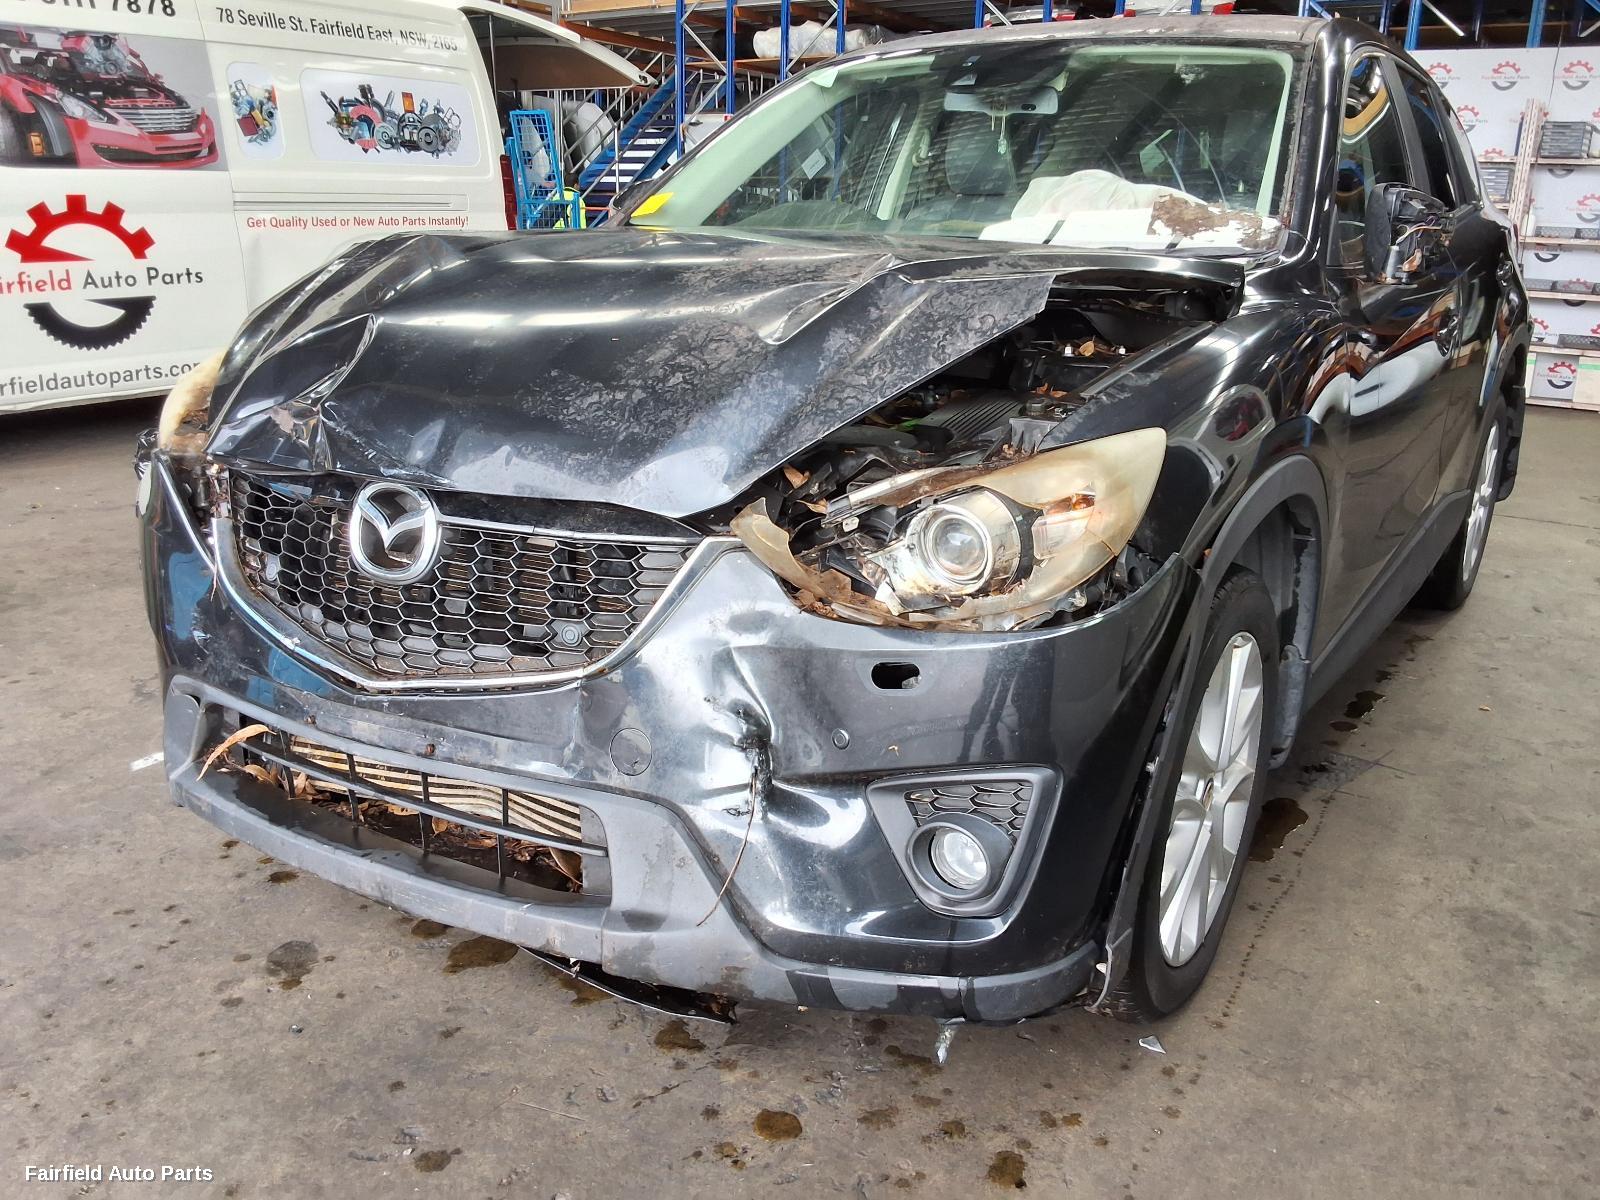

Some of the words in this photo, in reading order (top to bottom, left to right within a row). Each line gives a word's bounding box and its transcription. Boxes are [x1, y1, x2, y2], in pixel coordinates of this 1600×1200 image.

[215, 7, 234, 24] 78
[238, 9, 286, 29] Seville
[289, 16, 308, 32] St.
[311, 18, 364, 39] Fairfield
[367, 25, 398, 46] East,
[246, 216, 266, 228] Get
[270, 216, 308, 229] Quality
[311, 216, 337, 227] Used
[340, 218, 350, 227] or
[353, 216, 375, 227] New
[378, 216, 400, 227] Auto
[402, 216, 426, 226] Parts
[428, 216, 469, 229] Instantly!
[82, 269, 137, 290] Auto
[146, 266, 204, 286] Parts
[0, 362, 200, 396] rfieldautoparts.co
